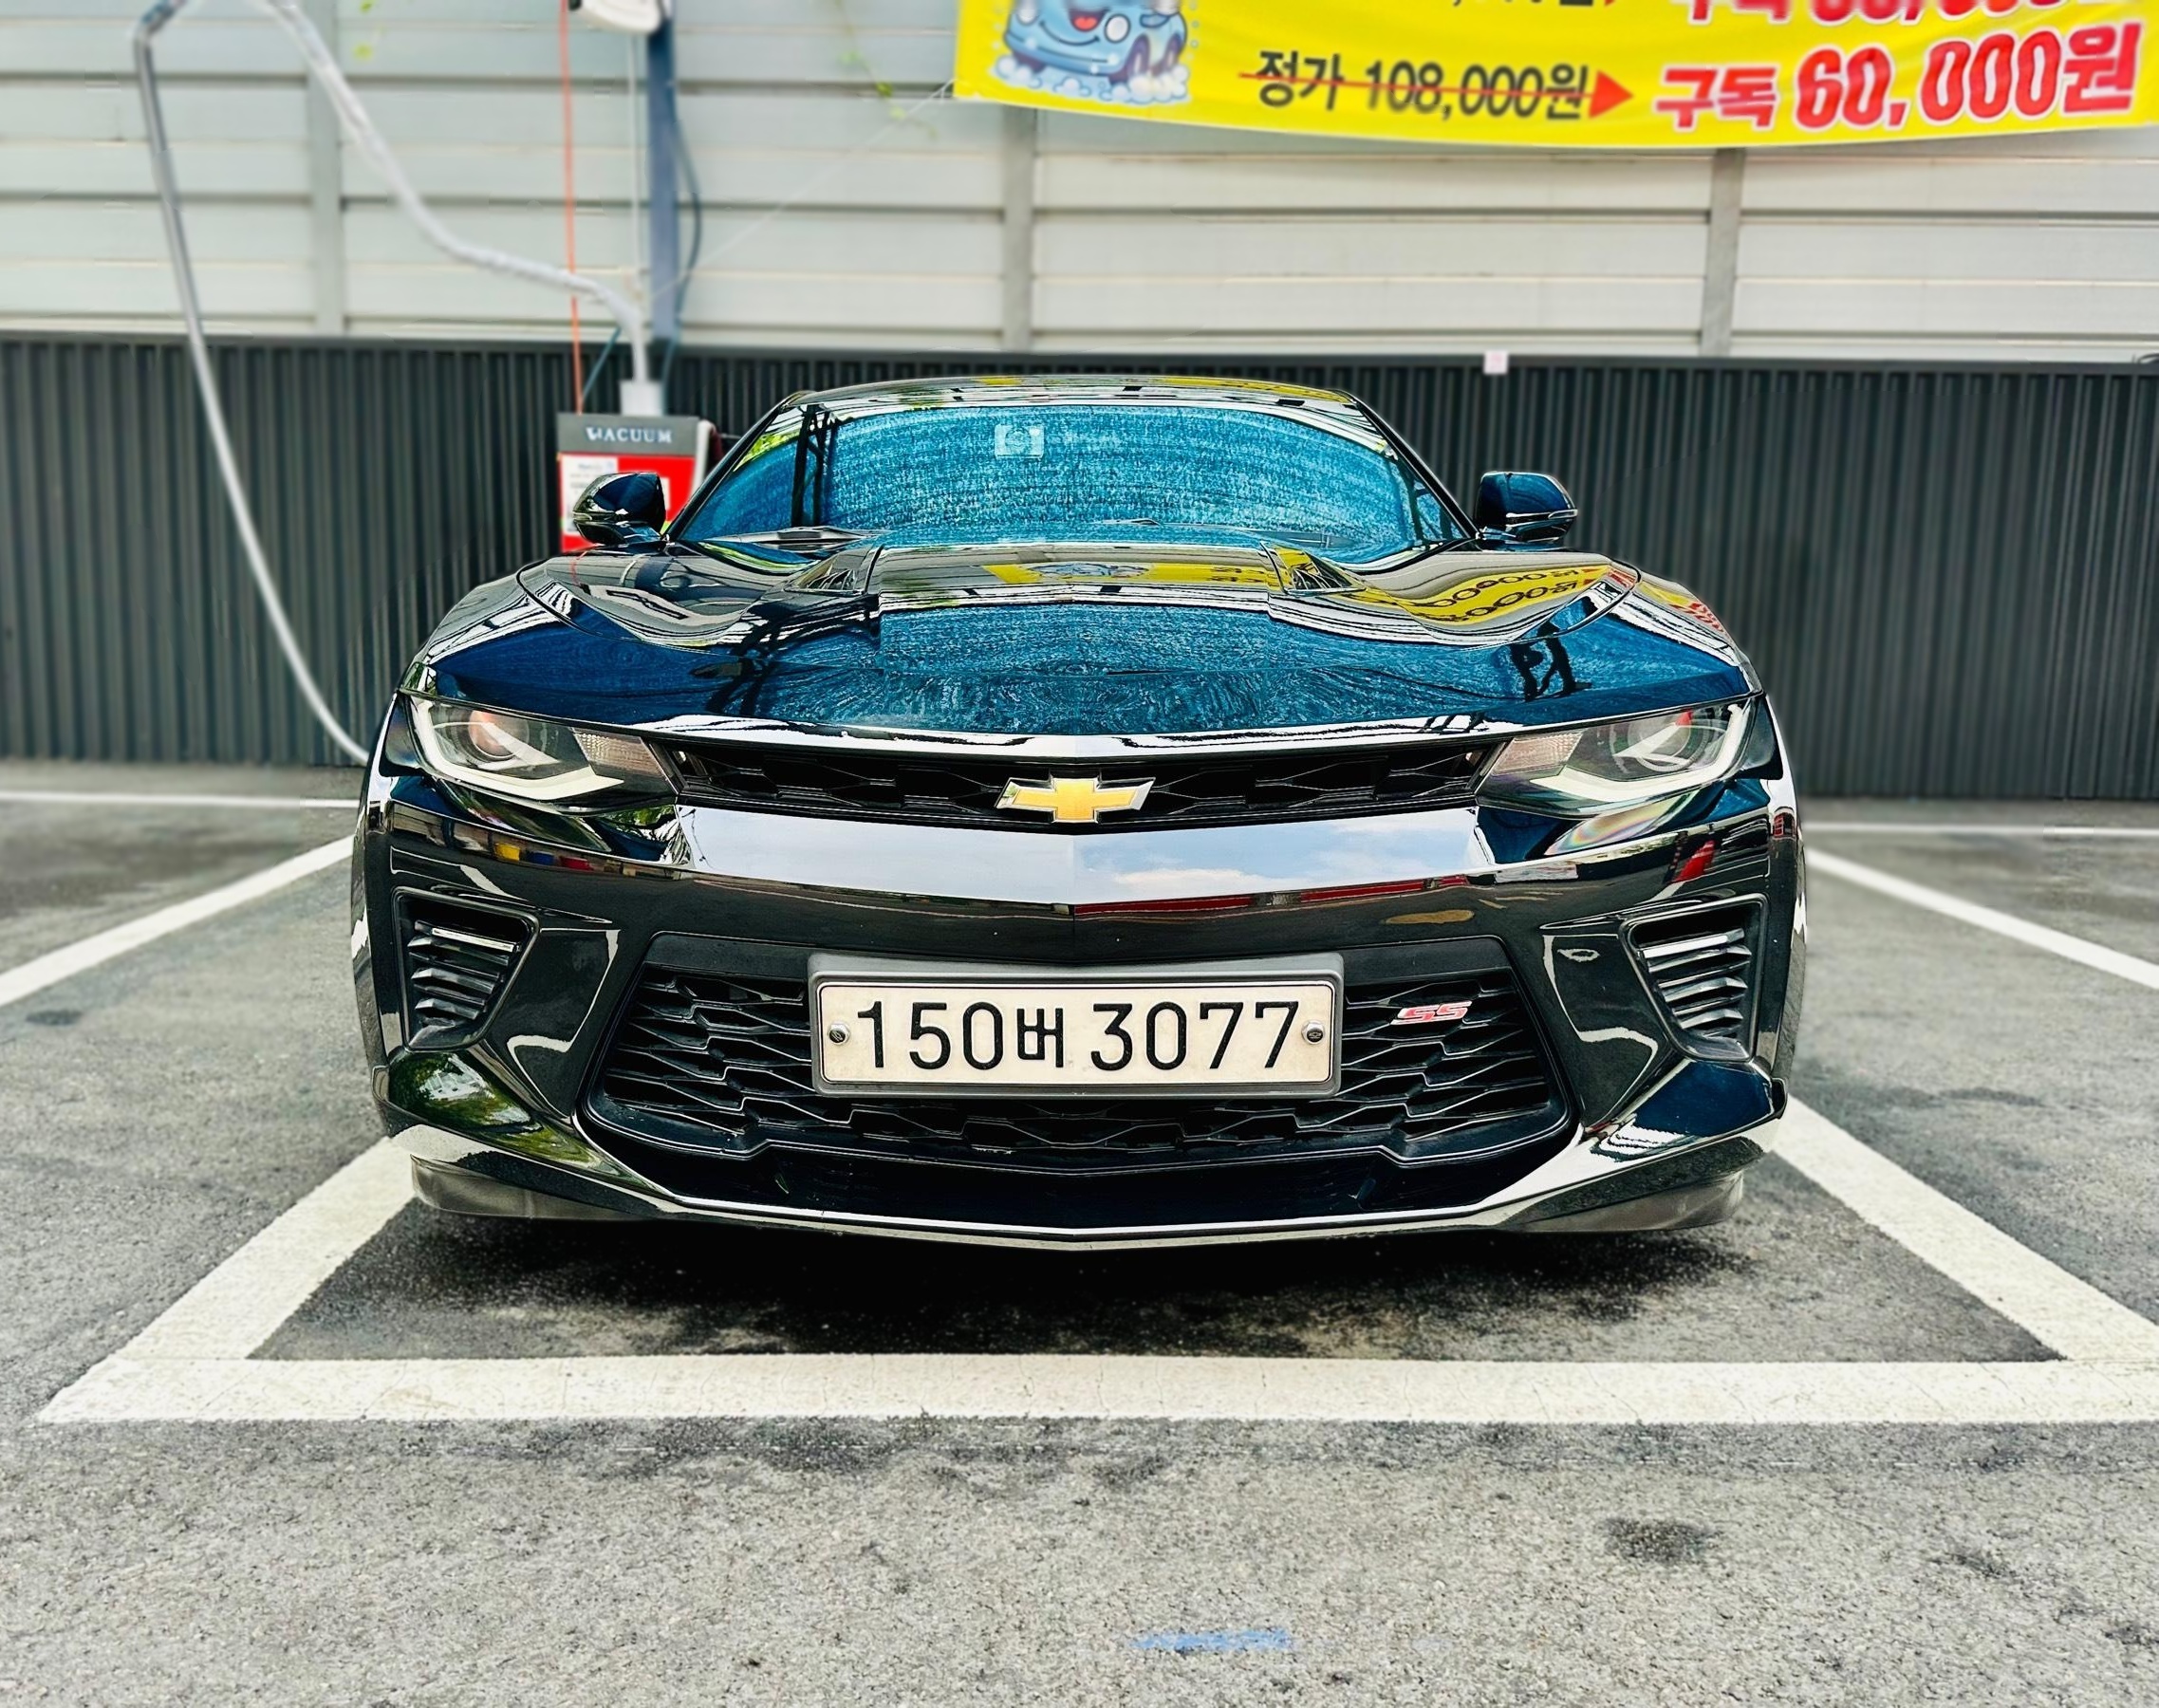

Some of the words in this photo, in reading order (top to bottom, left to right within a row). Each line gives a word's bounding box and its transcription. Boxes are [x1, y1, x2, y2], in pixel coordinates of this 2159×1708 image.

[1257, 50, 1346, 109] 정가
[1365, 61, 1589, 121] 108,000원
[1655, 66, 1777, 128] 구독
[585, 426, 672, 444] VACUUM
[856, 1001, 1064, 1071] 150버
[1090, 1001, 1300, 1071] 3077
[1389, 1000, 1473, 1026] SS
